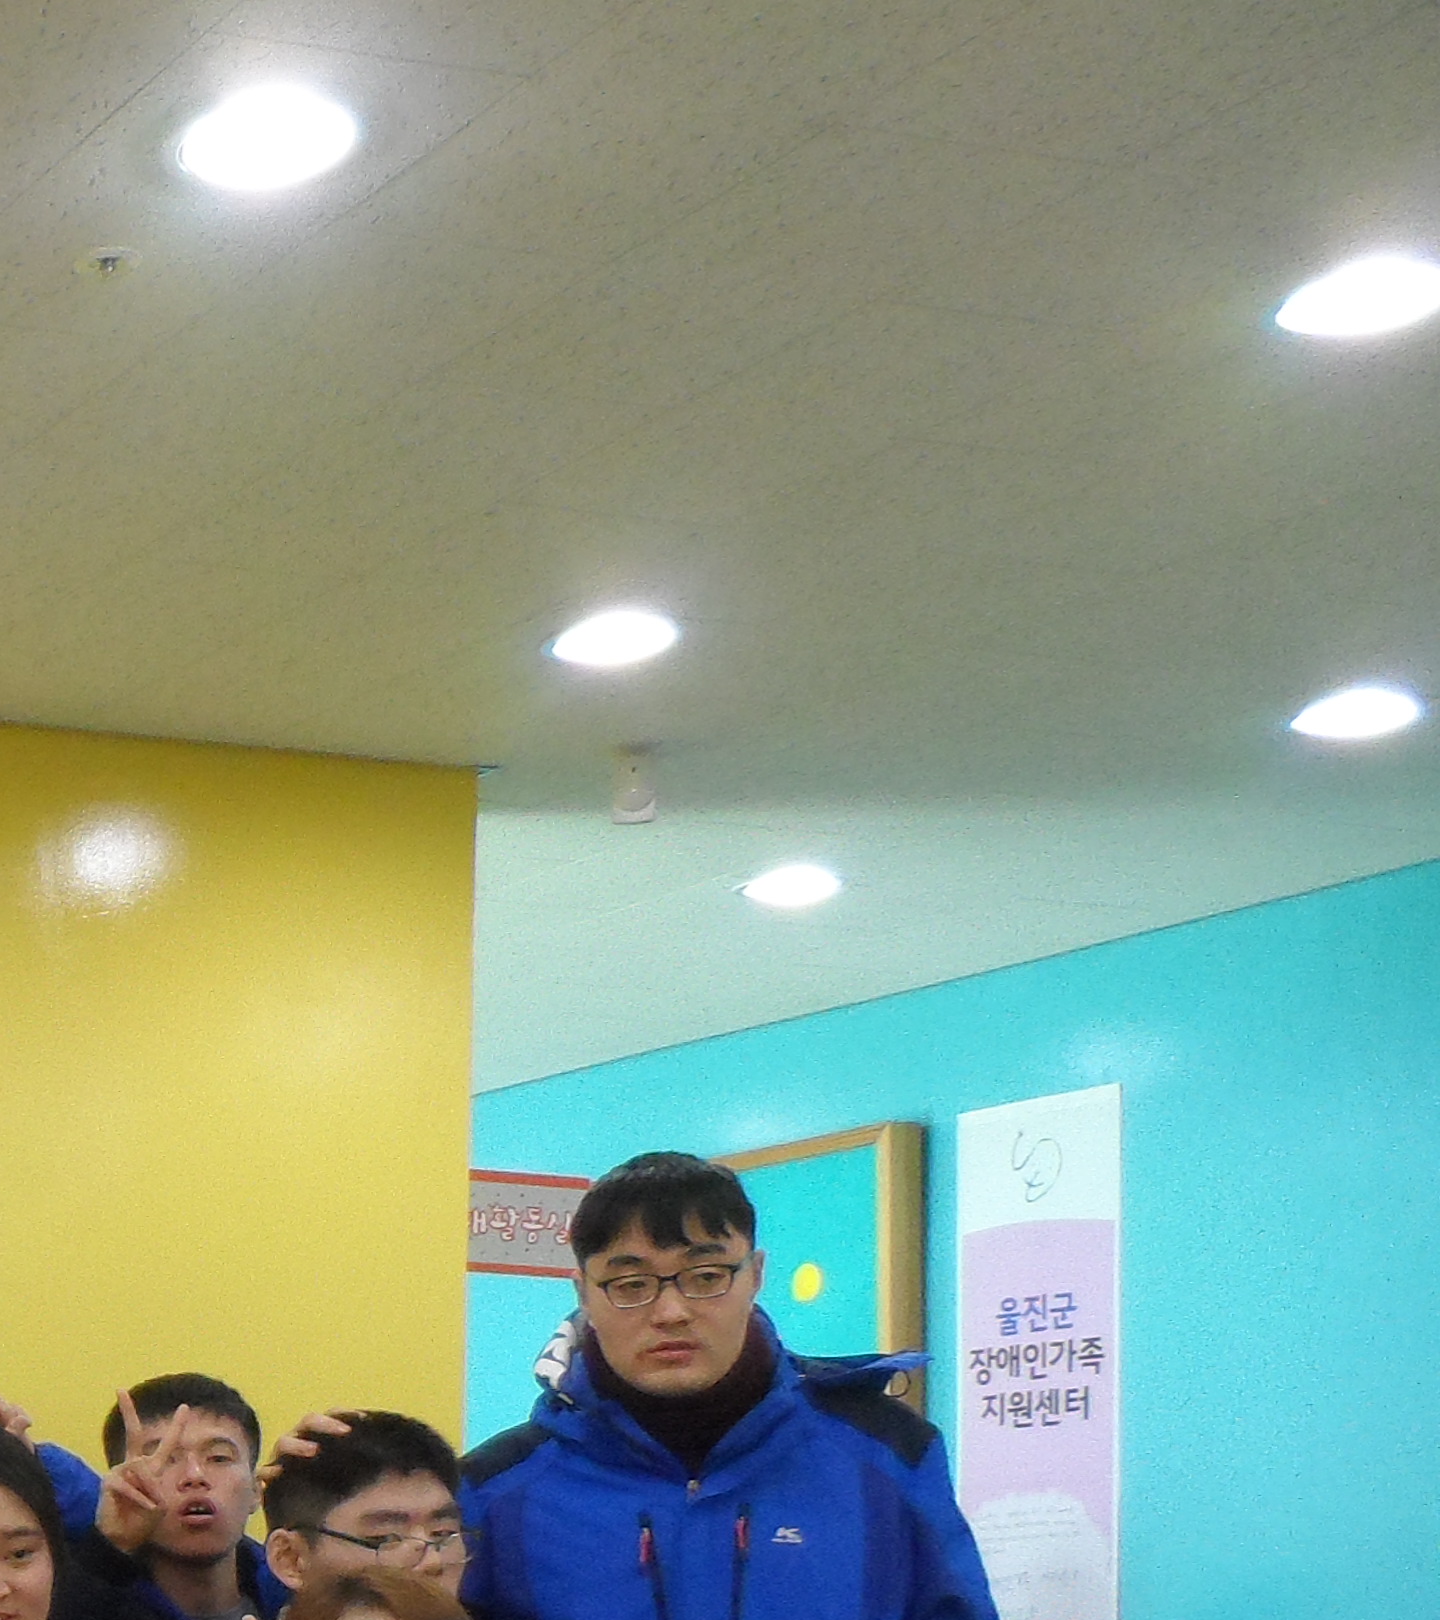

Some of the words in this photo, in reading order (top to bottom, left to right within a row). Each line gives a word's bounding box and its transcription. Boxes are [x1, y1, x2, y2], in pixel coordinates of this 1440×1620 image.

[995, 1292, 1079, 1336] 울진군
[969, 1337, 1105, 1385] 장애인가족
[981, 1386, 1089, 1428] 지원센터
